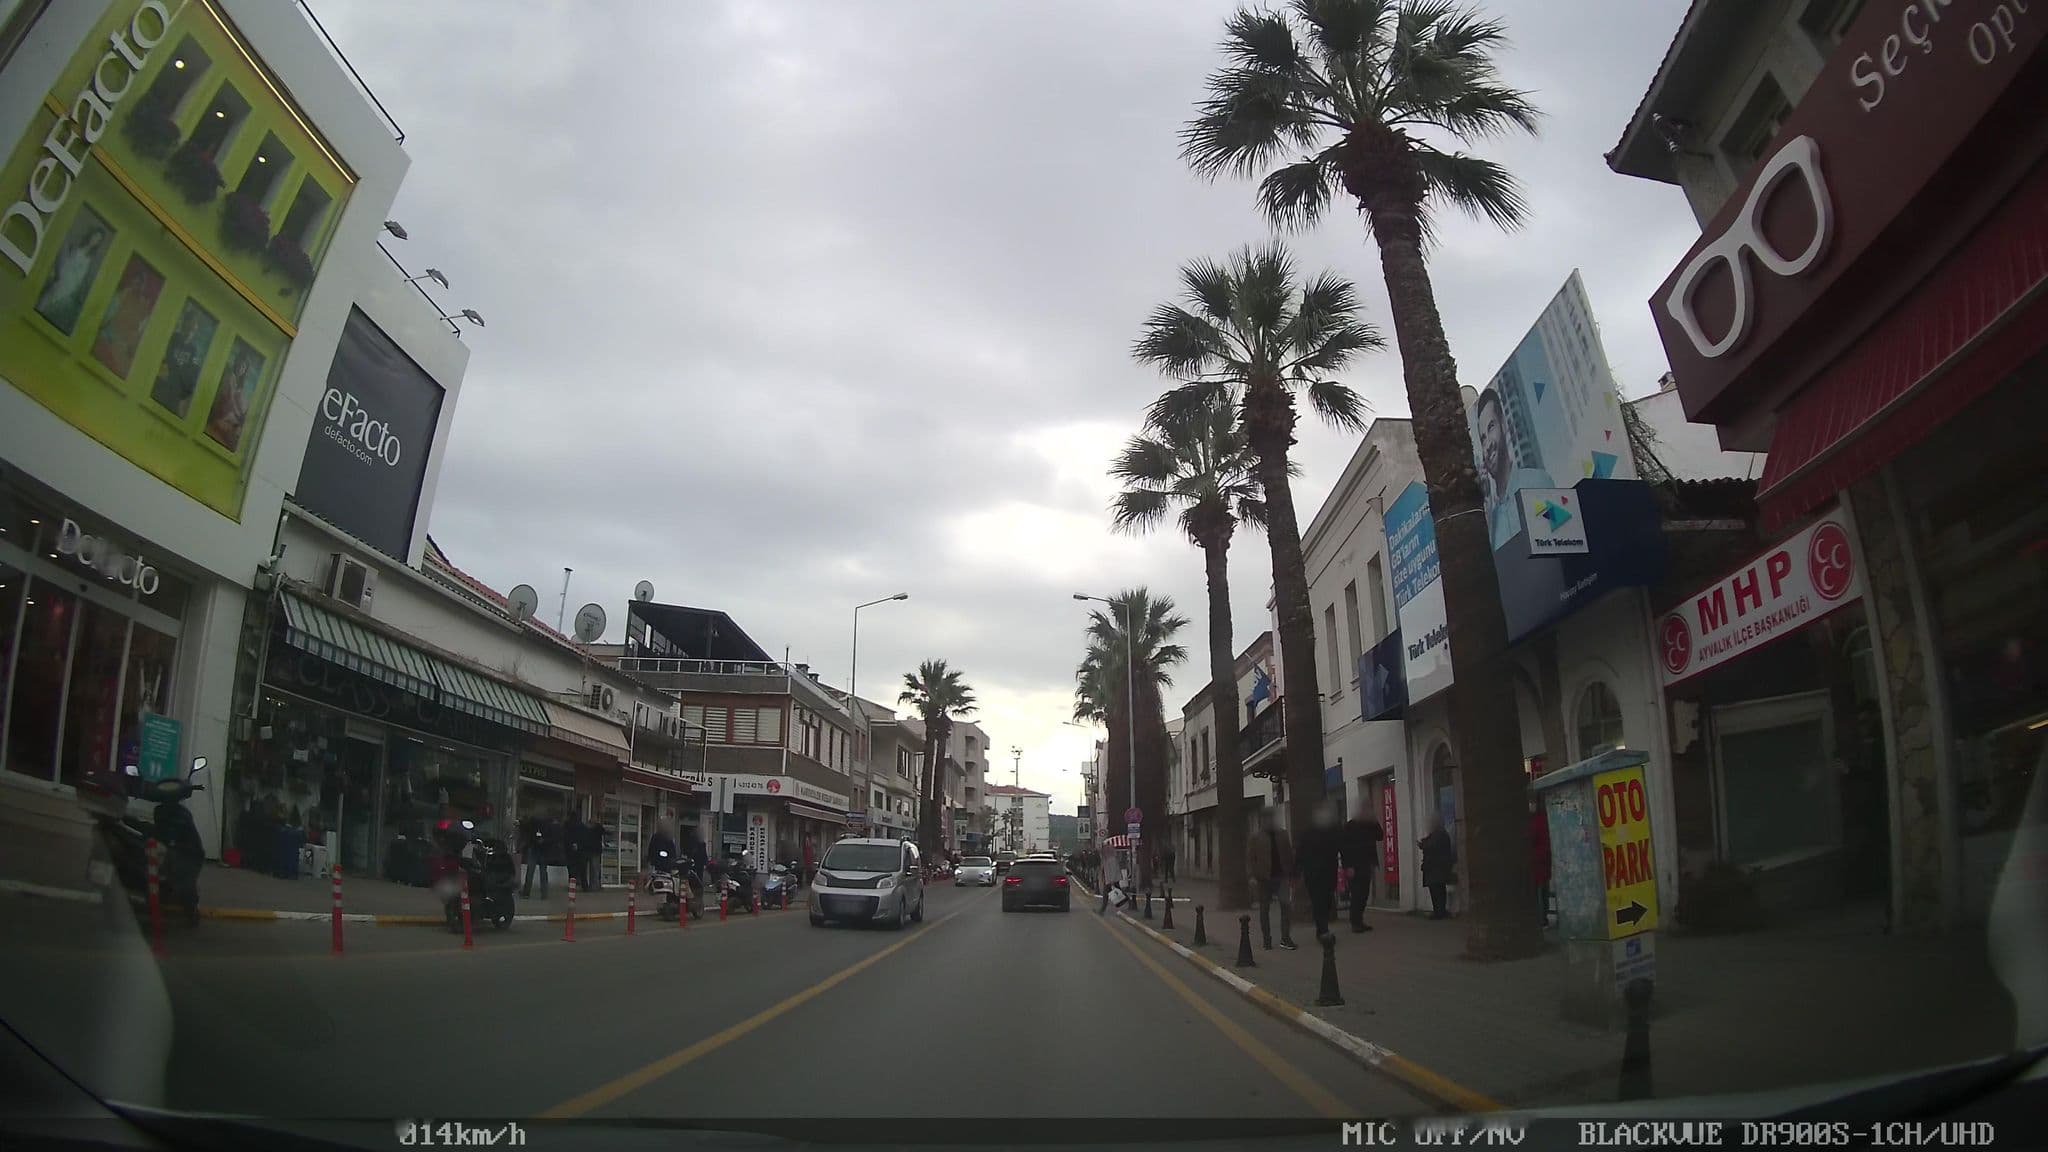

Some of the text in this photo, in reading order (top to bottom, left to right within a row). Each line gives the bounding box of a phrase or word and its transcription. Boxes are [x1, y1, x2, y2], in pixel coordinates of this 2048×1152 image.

[0, 1, 172, 277] DeFacto
[324, 424, 373, 467] defacto.com
[56, 518, 159, 595] Decto
[1535, 538, 1583, 547] Türk Telekom
[1697, 550, 1792, 636] MHP
[1408, 638, 1425, 661] Türk
[1699, 595, 1812, 663] AYVALIK İLÇE BAŞKANLIĞI
[1598, 779, 1646, 828] OTO
[1602, 838, 1654, 890] PARK
